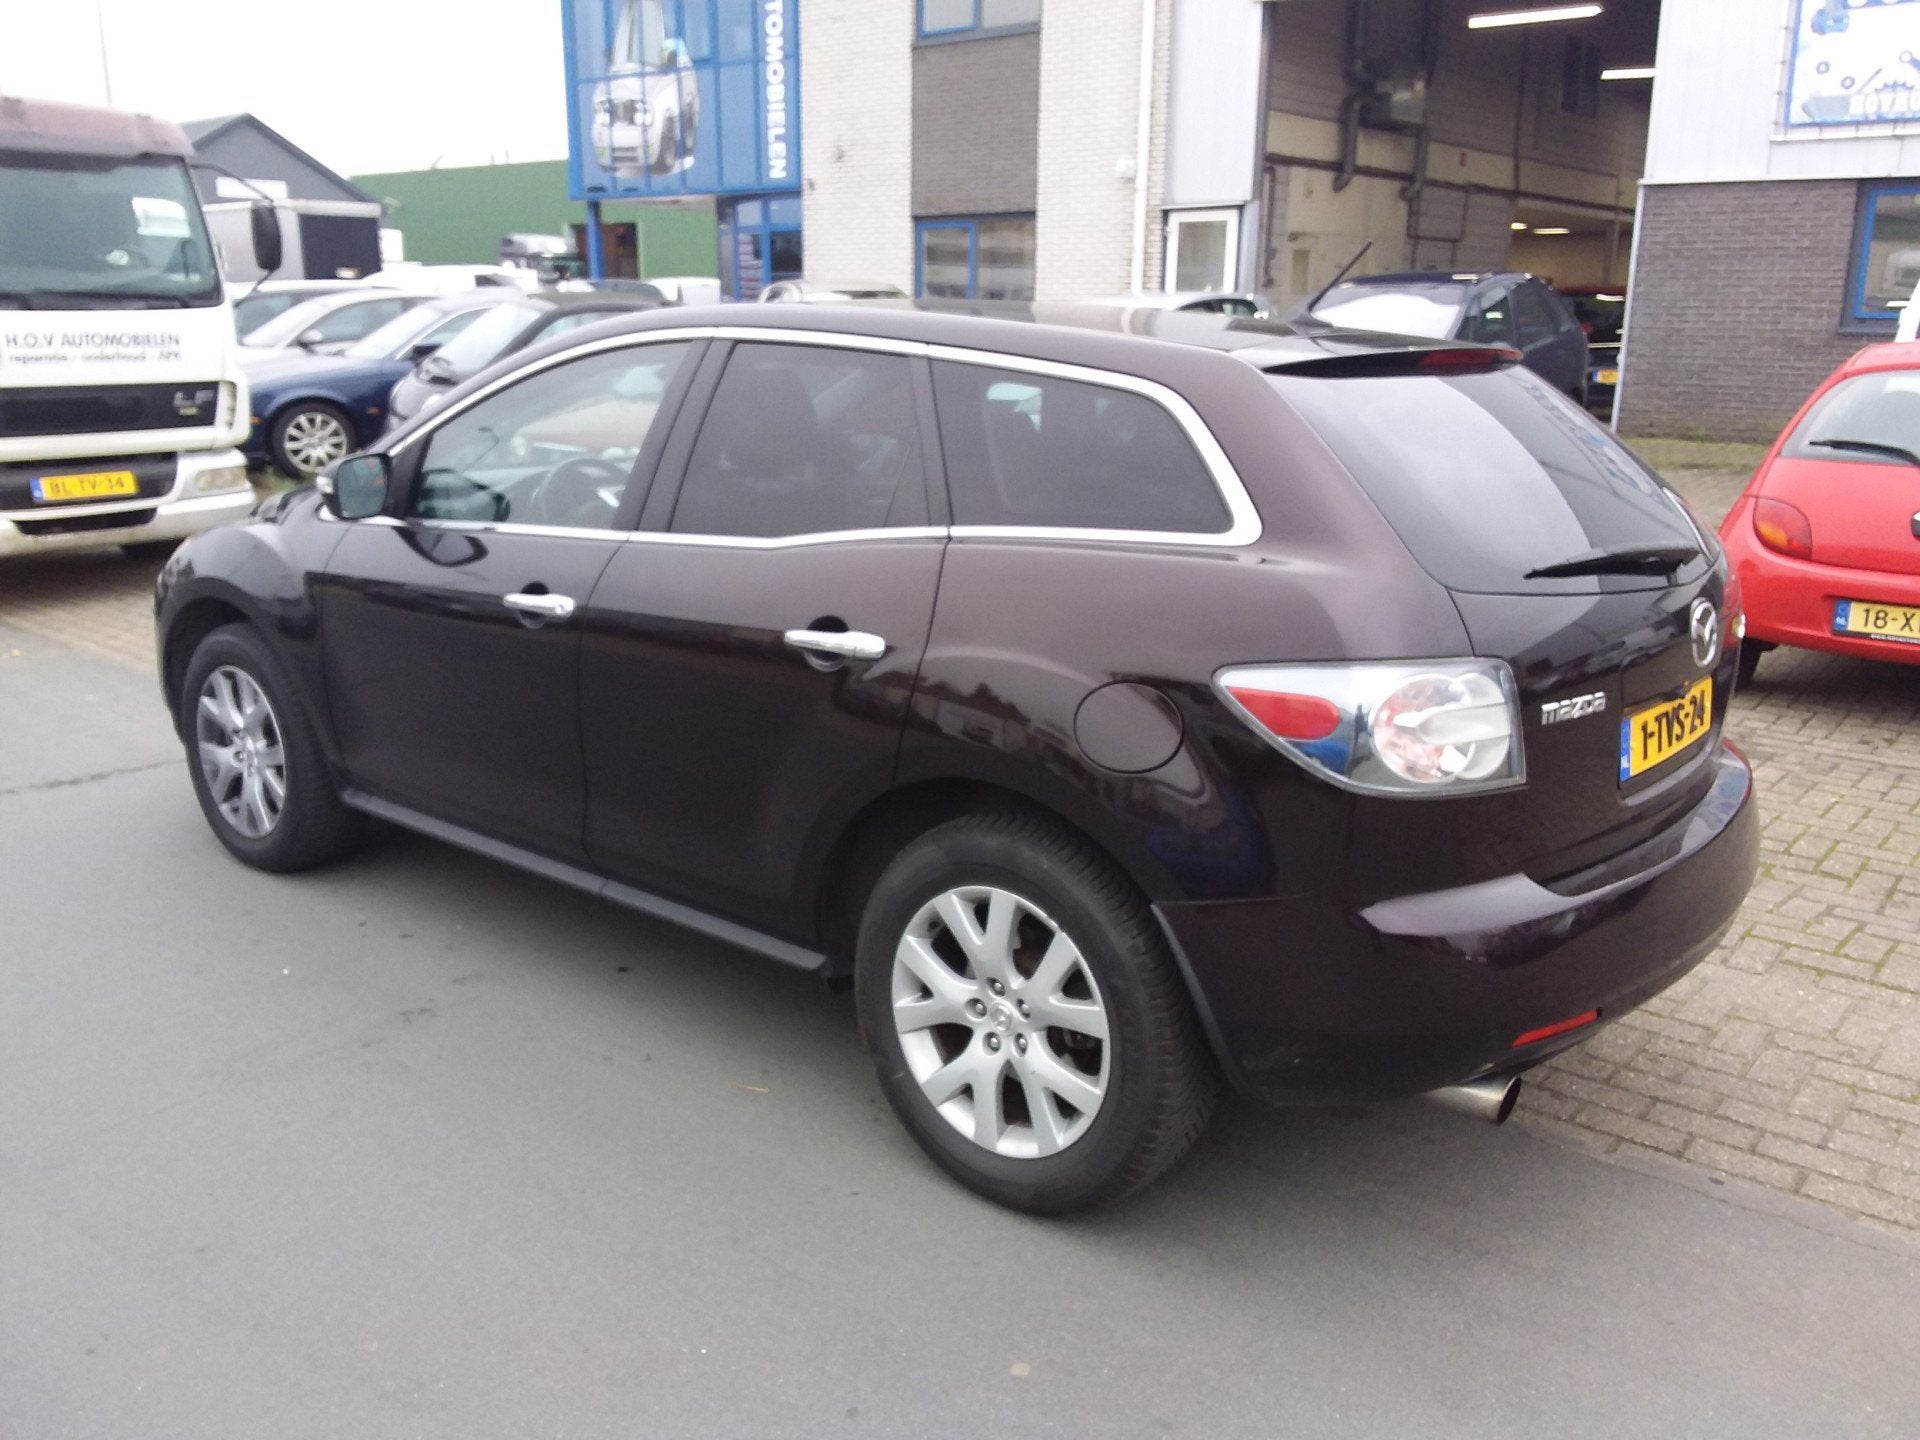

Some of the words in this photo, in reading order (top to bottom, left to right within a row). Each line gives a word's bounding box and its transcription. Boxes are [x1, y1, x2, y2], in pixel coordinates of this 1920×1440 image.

[61, 333, 180, 347] AUTOMOBIELEN
[1863, 608, 1920, 633] 18-X
[1641, 690, 1706, 760] 1-TVS-24
